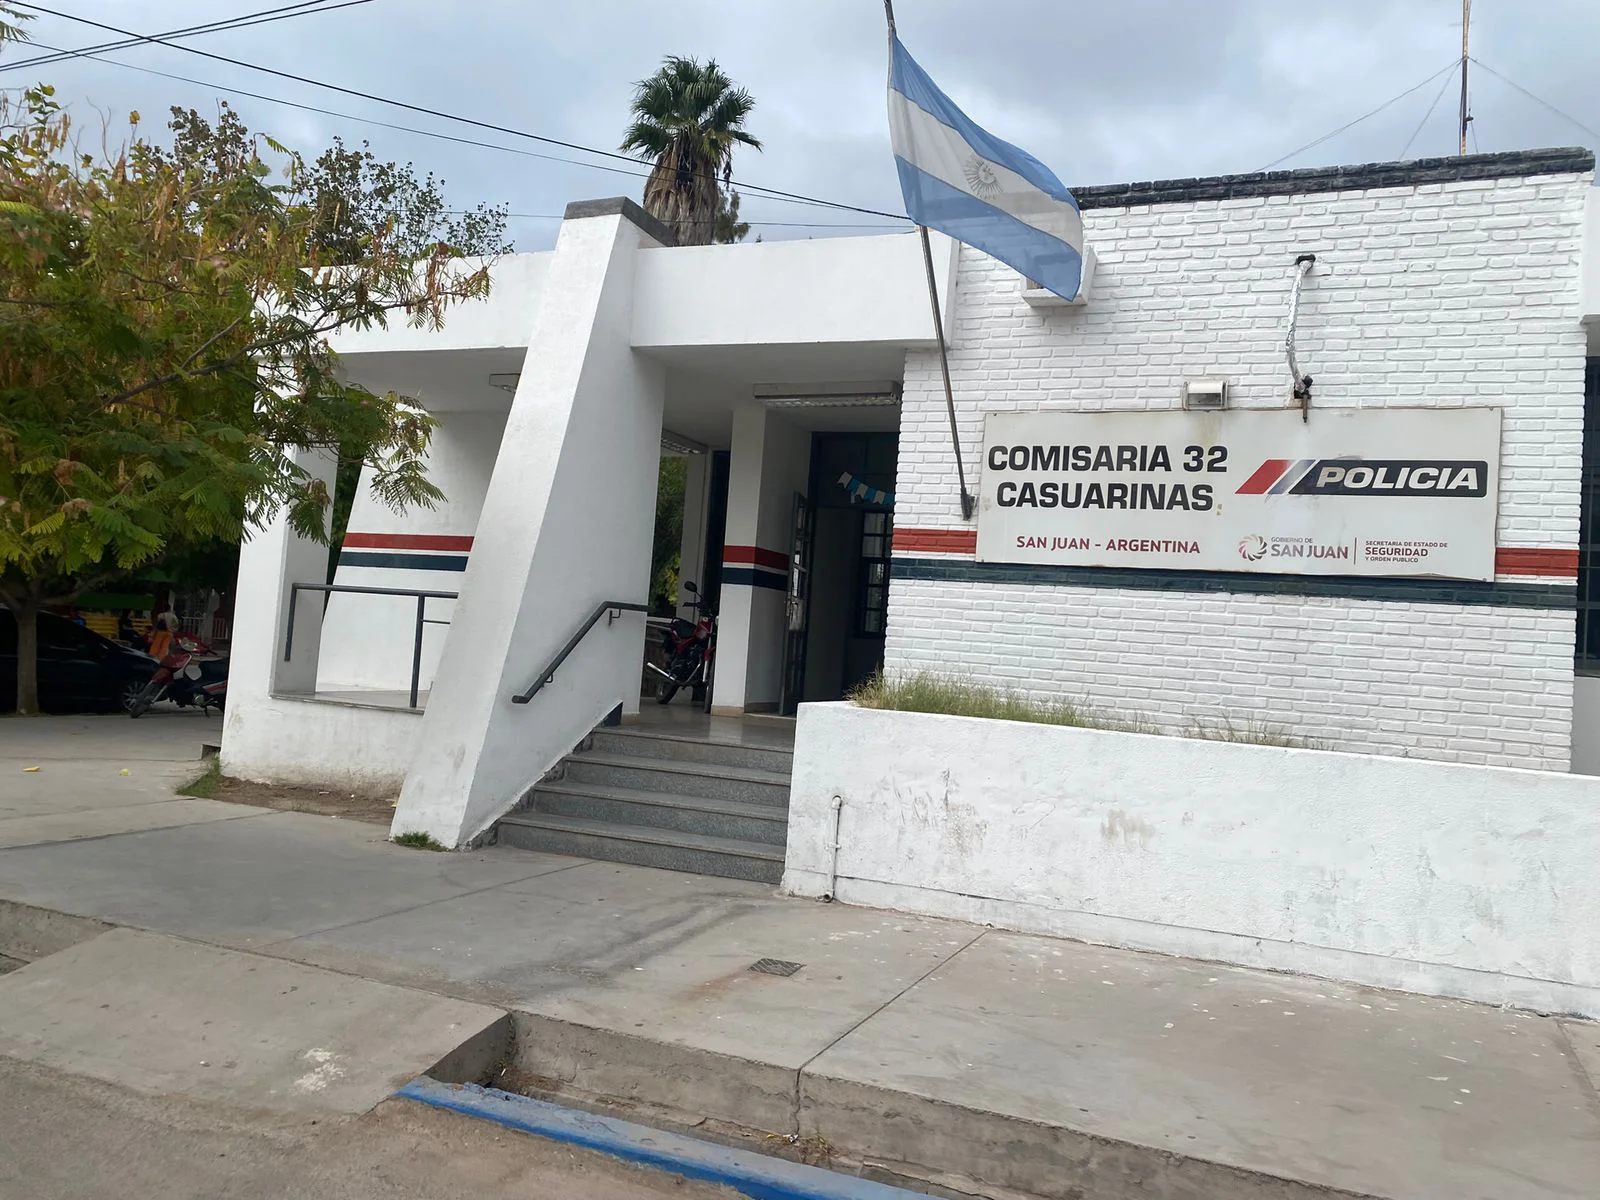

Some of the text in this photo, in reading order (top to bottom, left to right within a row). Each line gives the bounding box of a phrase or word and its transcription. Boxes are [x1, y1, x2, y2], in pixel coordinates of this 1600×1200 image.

[988, 445, 1228, 473] COMISARIA 32
[1315, 466, 1479, 490] POLICIA
[996, 481, 1214, 511] CASUARINAS
[1016, 535, 1047, 549] SAN
[1051, 537, 1090, 551] JUAN
[1106, 539, 1201, 554] ARGENTINA
[1270, 543, 1349, 559] SAN JUAN
[1365, 546, 1429, 557] SEGURIDAD
